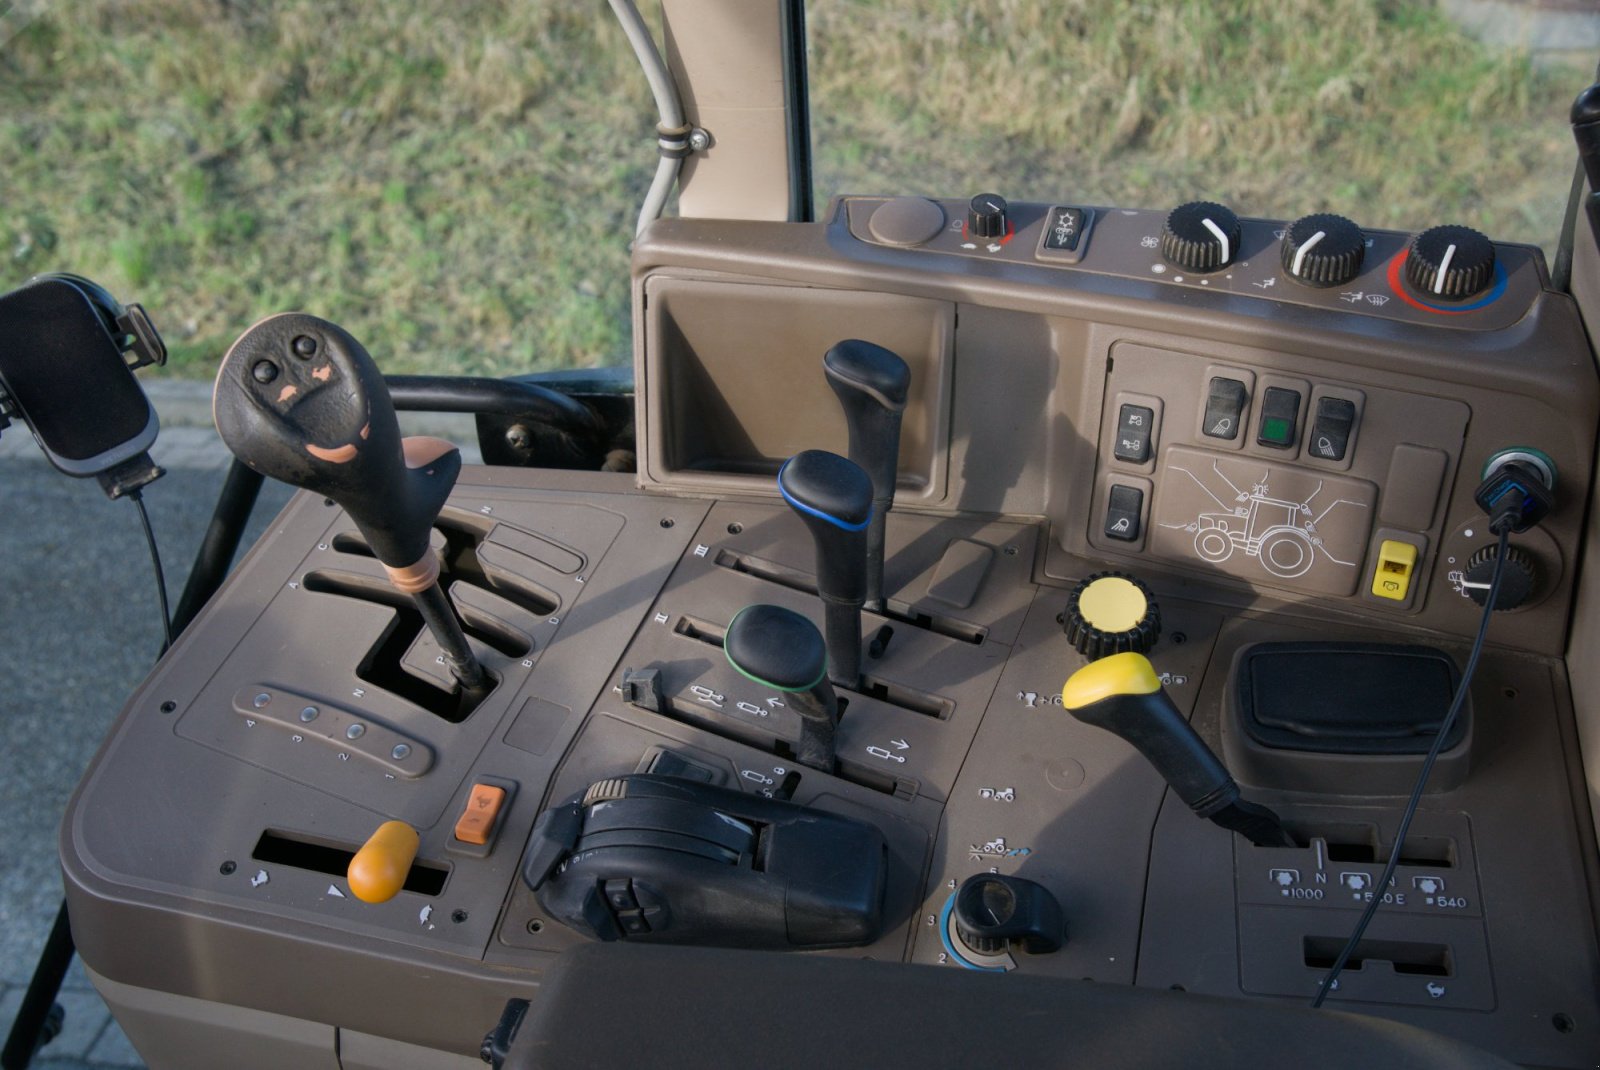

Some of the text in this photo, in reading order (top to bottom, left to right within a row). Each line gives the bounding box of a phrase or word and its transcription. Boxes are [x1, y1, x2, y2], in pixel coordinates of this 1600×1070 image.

[317, 543, 328, 551] C
[575, 576, 585, 584] F
[288, 582, 299, 590] A
[548, 616, 560, 625] D
[435, 655, 446, 665] P
[521, 659, 533, 668] B
[352, 688, 364, 698] N
[246, 718, 257, 729] 4
[292, 733, 303, 744] 3
[338, 753, 349, 761] 2
[1315, 872, 1327, 884] N
[947, 879, 956, 890] 4
[1291, 887, 1324, 900] 1000
[1364, 892, 1393, 904] 50
[1437, 895, 1467, 908] 540
[927, 915, 936, 927] 3
[937, 952, 947, 964] 2
